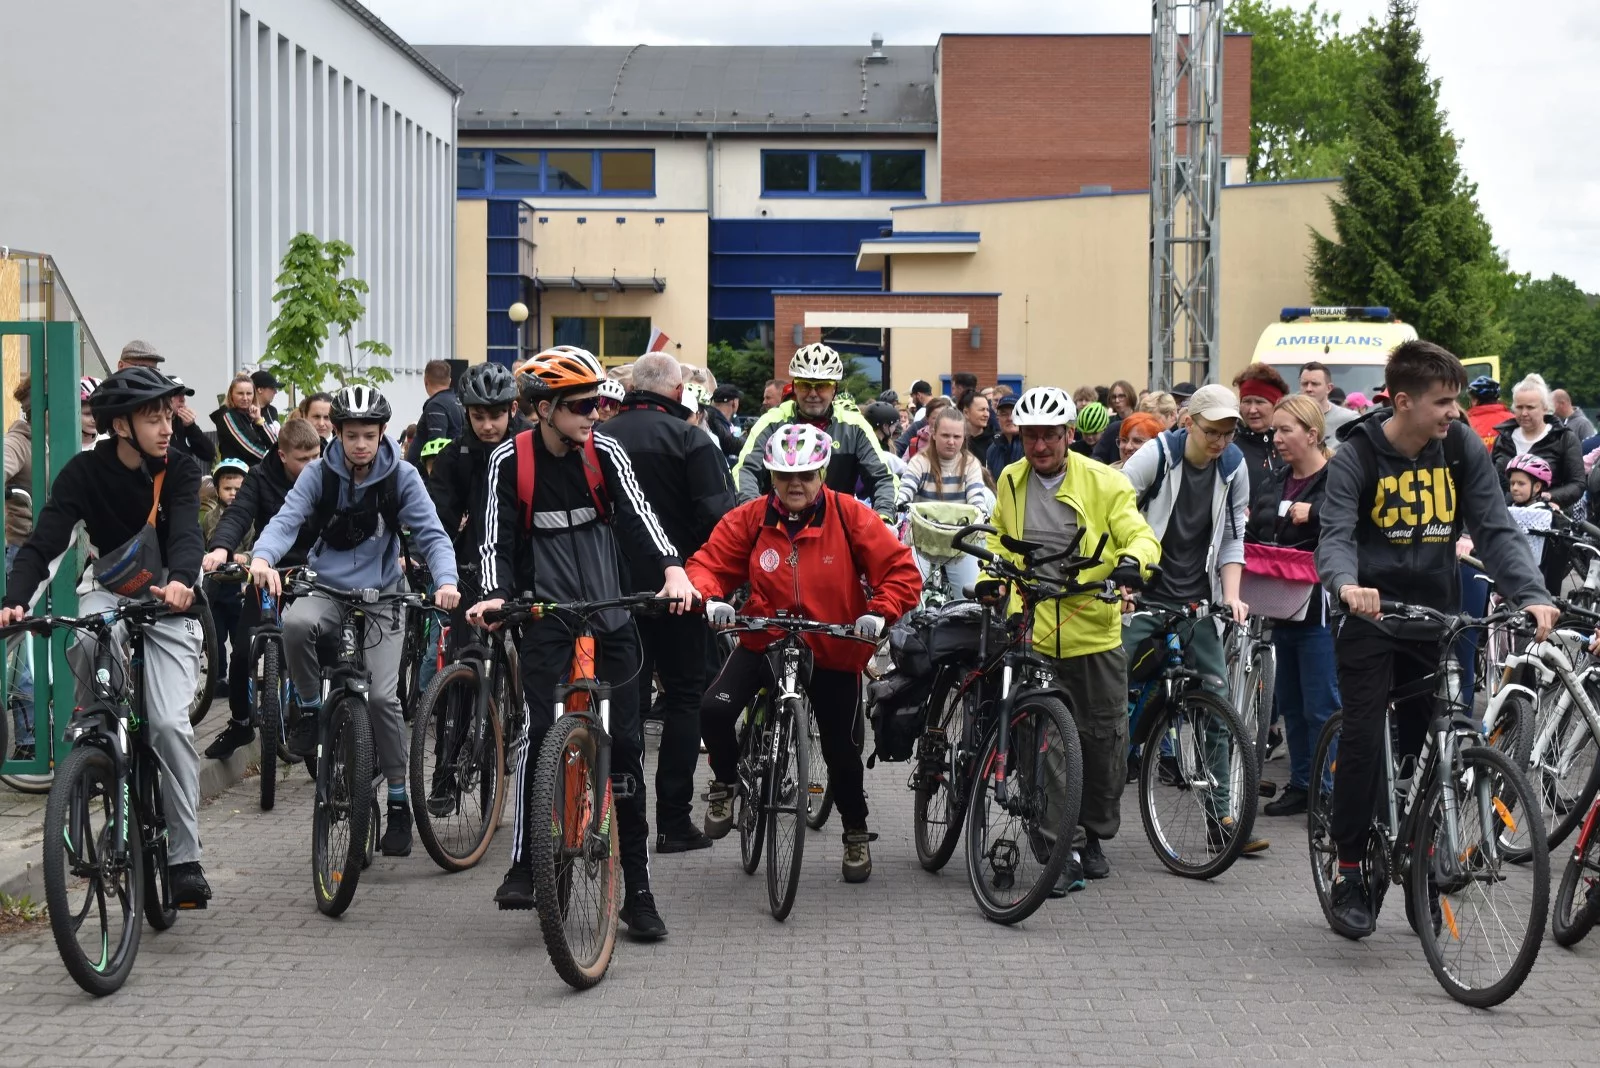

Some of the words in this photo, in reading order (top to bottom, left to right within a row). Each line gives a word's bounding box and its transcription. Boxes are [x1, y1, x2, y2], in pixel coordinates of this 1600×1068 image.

[1310, 307, 1347, 316] AMBULANS
[1276, 335, 1383, 347] AMBULANS
[1371, 467, 1457, 528] CSU
